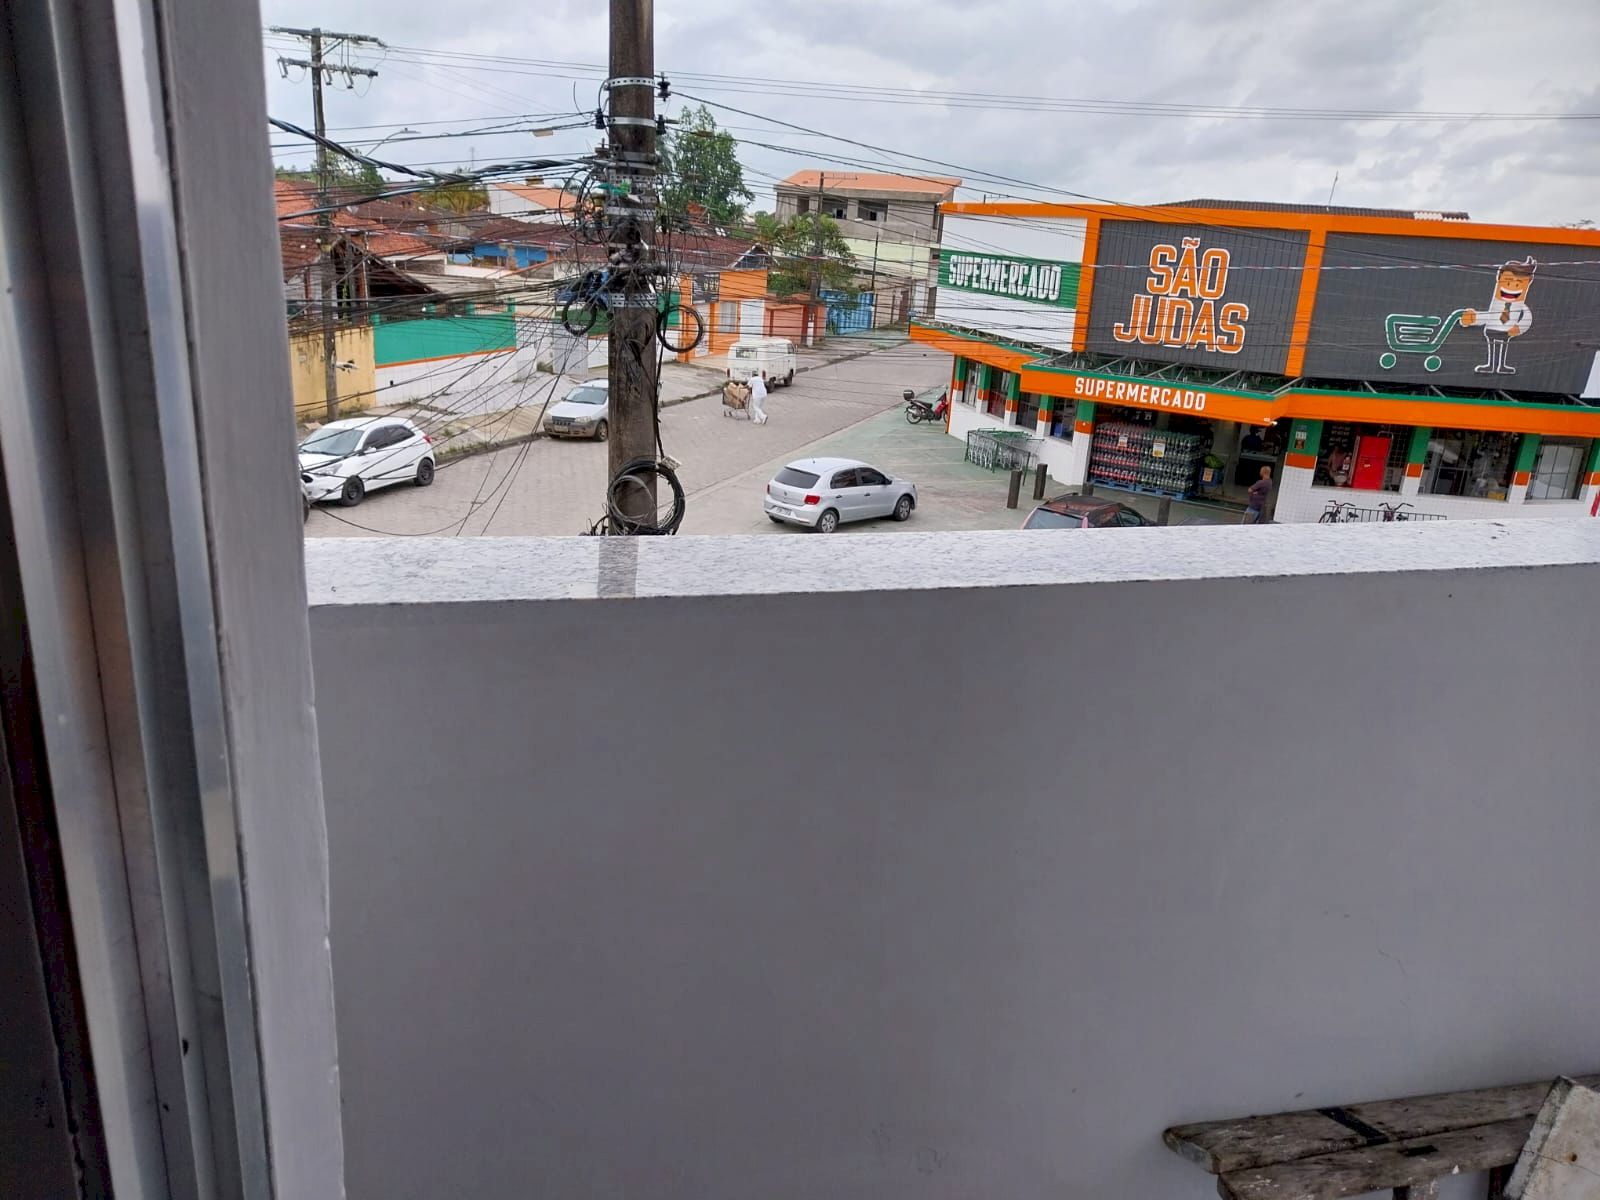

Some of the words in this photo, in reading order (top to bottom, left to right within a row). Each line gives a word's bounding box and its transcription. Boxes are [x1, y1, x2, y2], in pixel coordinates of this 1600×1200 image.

[949, 255, 1062, 300] SUPERMERCADO
[1147, 237, 1230, 299] SÃO
[1114, 294, 1249, 353] JUDAS
[1075, 377, 1206, 411] SUPERMERCADO
